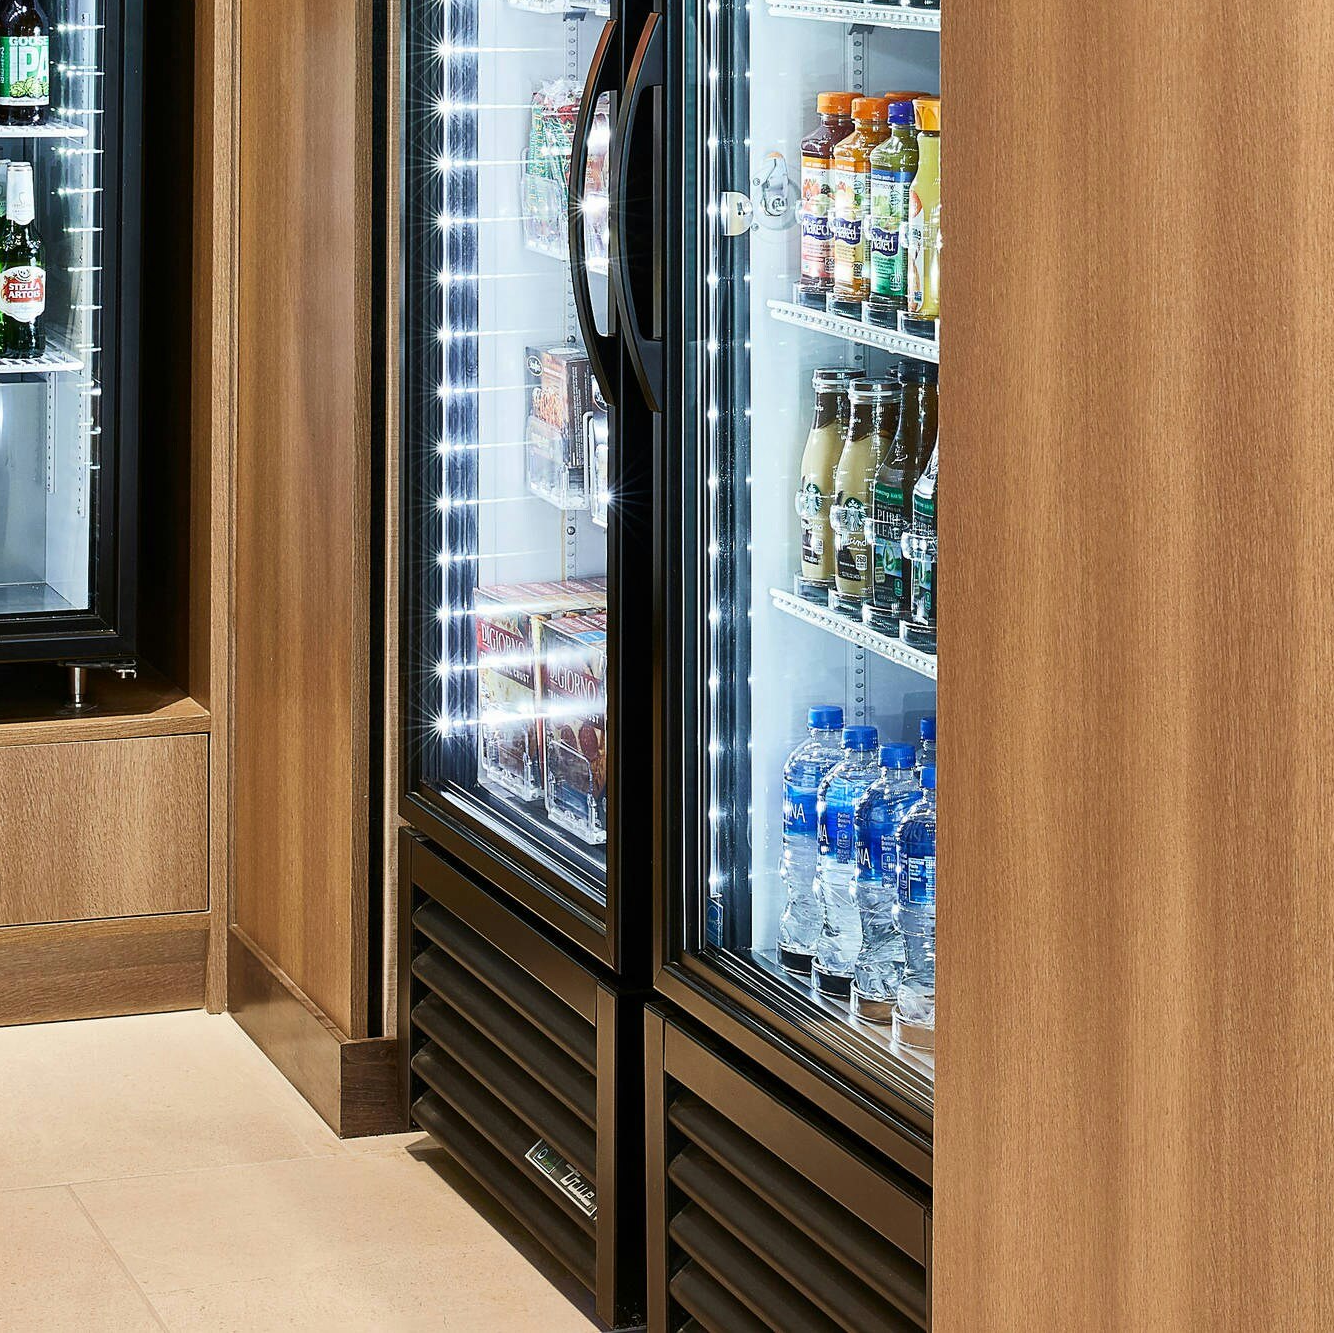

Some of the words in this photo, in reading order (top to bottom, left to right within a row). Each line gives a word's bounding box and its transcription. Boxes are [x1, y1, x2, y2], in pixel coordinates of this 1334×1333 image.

[9, 36, 49, 46] GOOSE
[9, 46, 49, 85] IPA
[8, 282, 40, 291] STELLA
[8, 290, 41, 299] ARTOIS
